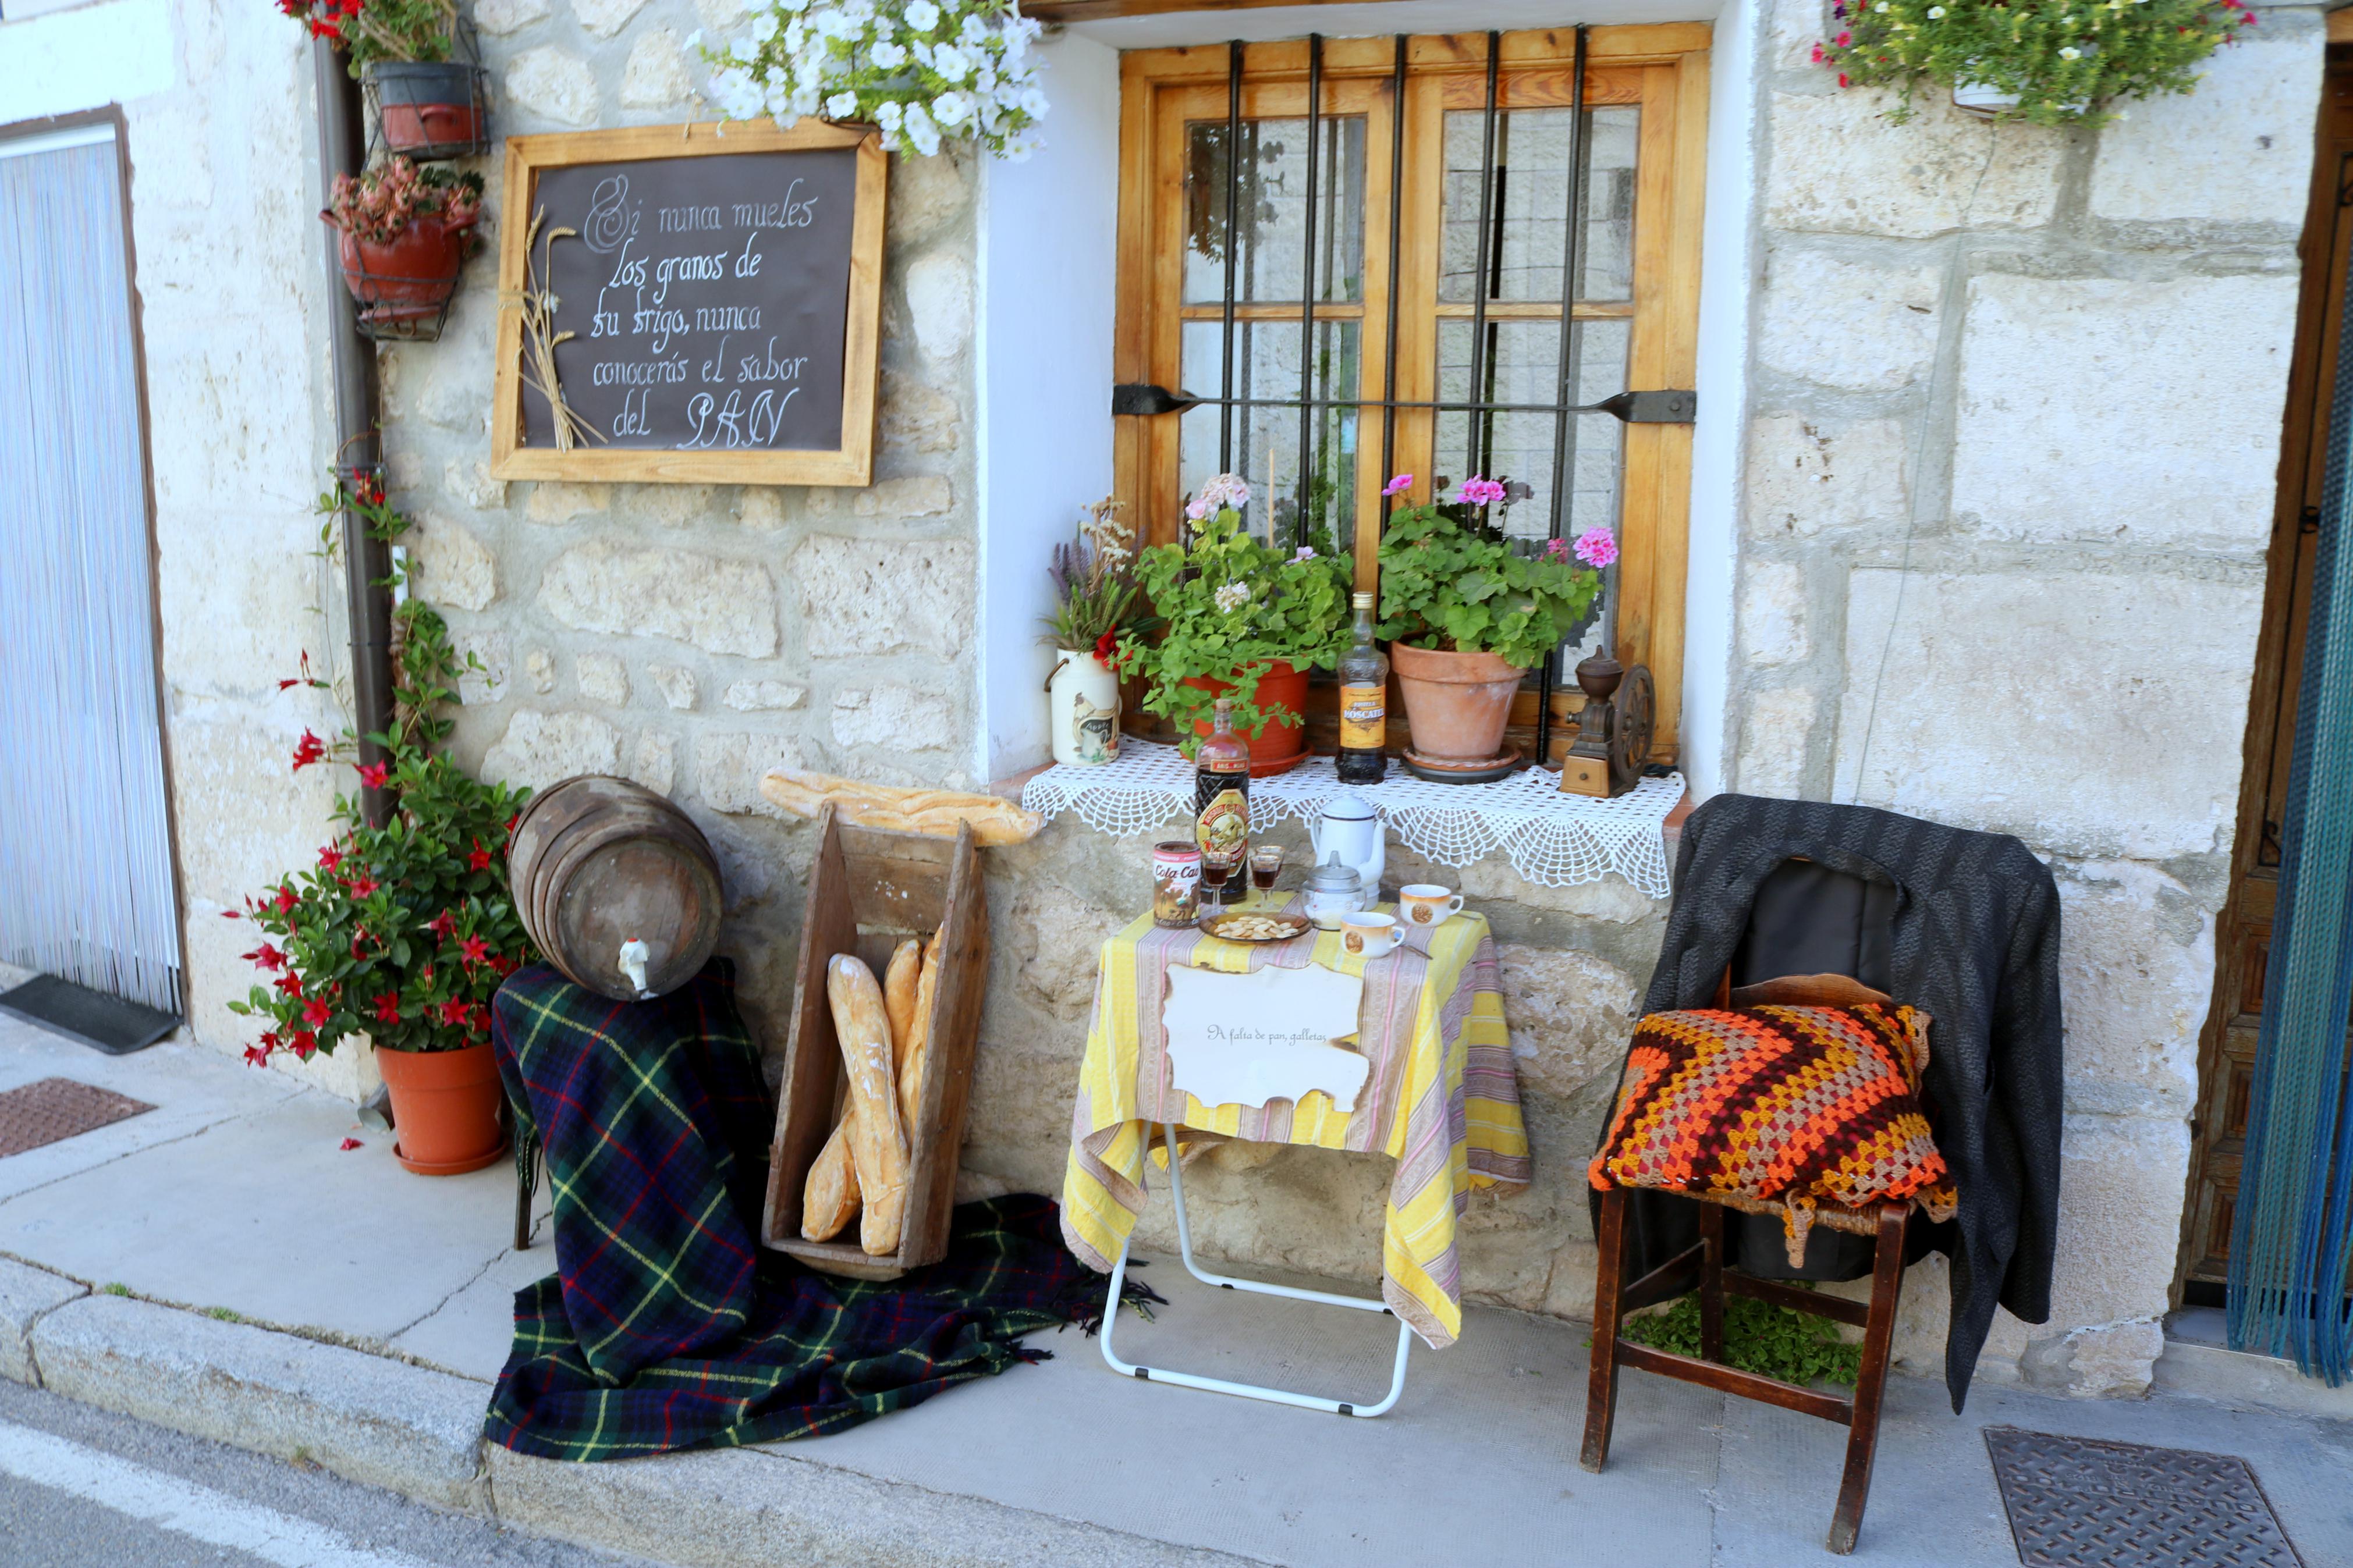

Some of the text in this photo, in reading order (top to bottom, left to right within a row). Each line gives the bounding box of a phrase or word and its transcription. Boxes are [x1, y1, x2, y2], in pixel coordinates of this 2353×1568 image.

[584, 174, 819, 254] Si nunca mueles
[653, 250, 728, 305] granos
[735, 232, 762, 279] de
[695, 305, 761, 332] nunca
[592, 334, 808, 386] conocerás el sabor
[613, 386, 800, 449] del PAN
[1207, 1024, 1326, 1046] A falta de pan, galletas
